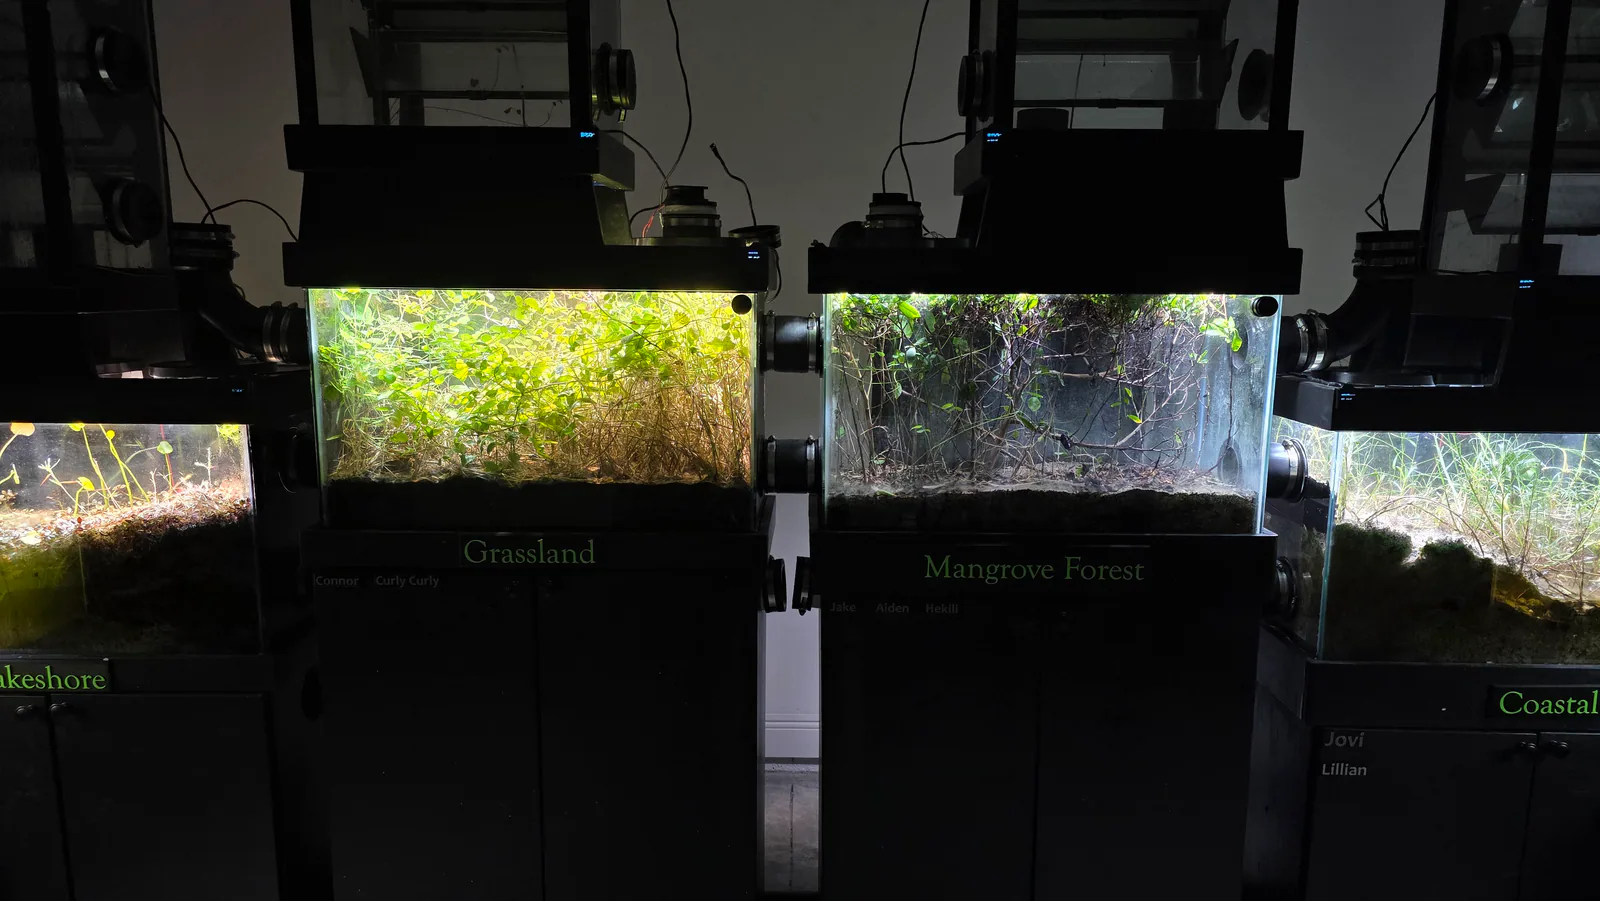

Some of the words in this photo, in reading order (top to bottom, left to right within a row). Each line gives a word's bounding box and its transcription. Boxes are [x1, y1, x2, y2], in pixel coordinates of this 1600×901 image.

[463, 538, 597, 564] Grassland
[924, 554, 1055, 585] Mangrove
[1064, 555, 1145, 581] Forest
[315, 575, 360, 586] Connor
[375, 575, 406, 588] Curly
[408, 575, 440, 588] Curly
[829, 601, 857, 612] Jake
[875, 602, 910, 613] Aiden
[1499, 689, 1600, 715] Coastal
[1324, 731, 1365, 748] Jovi
[1321, 762, 1368, 776] Lillian
